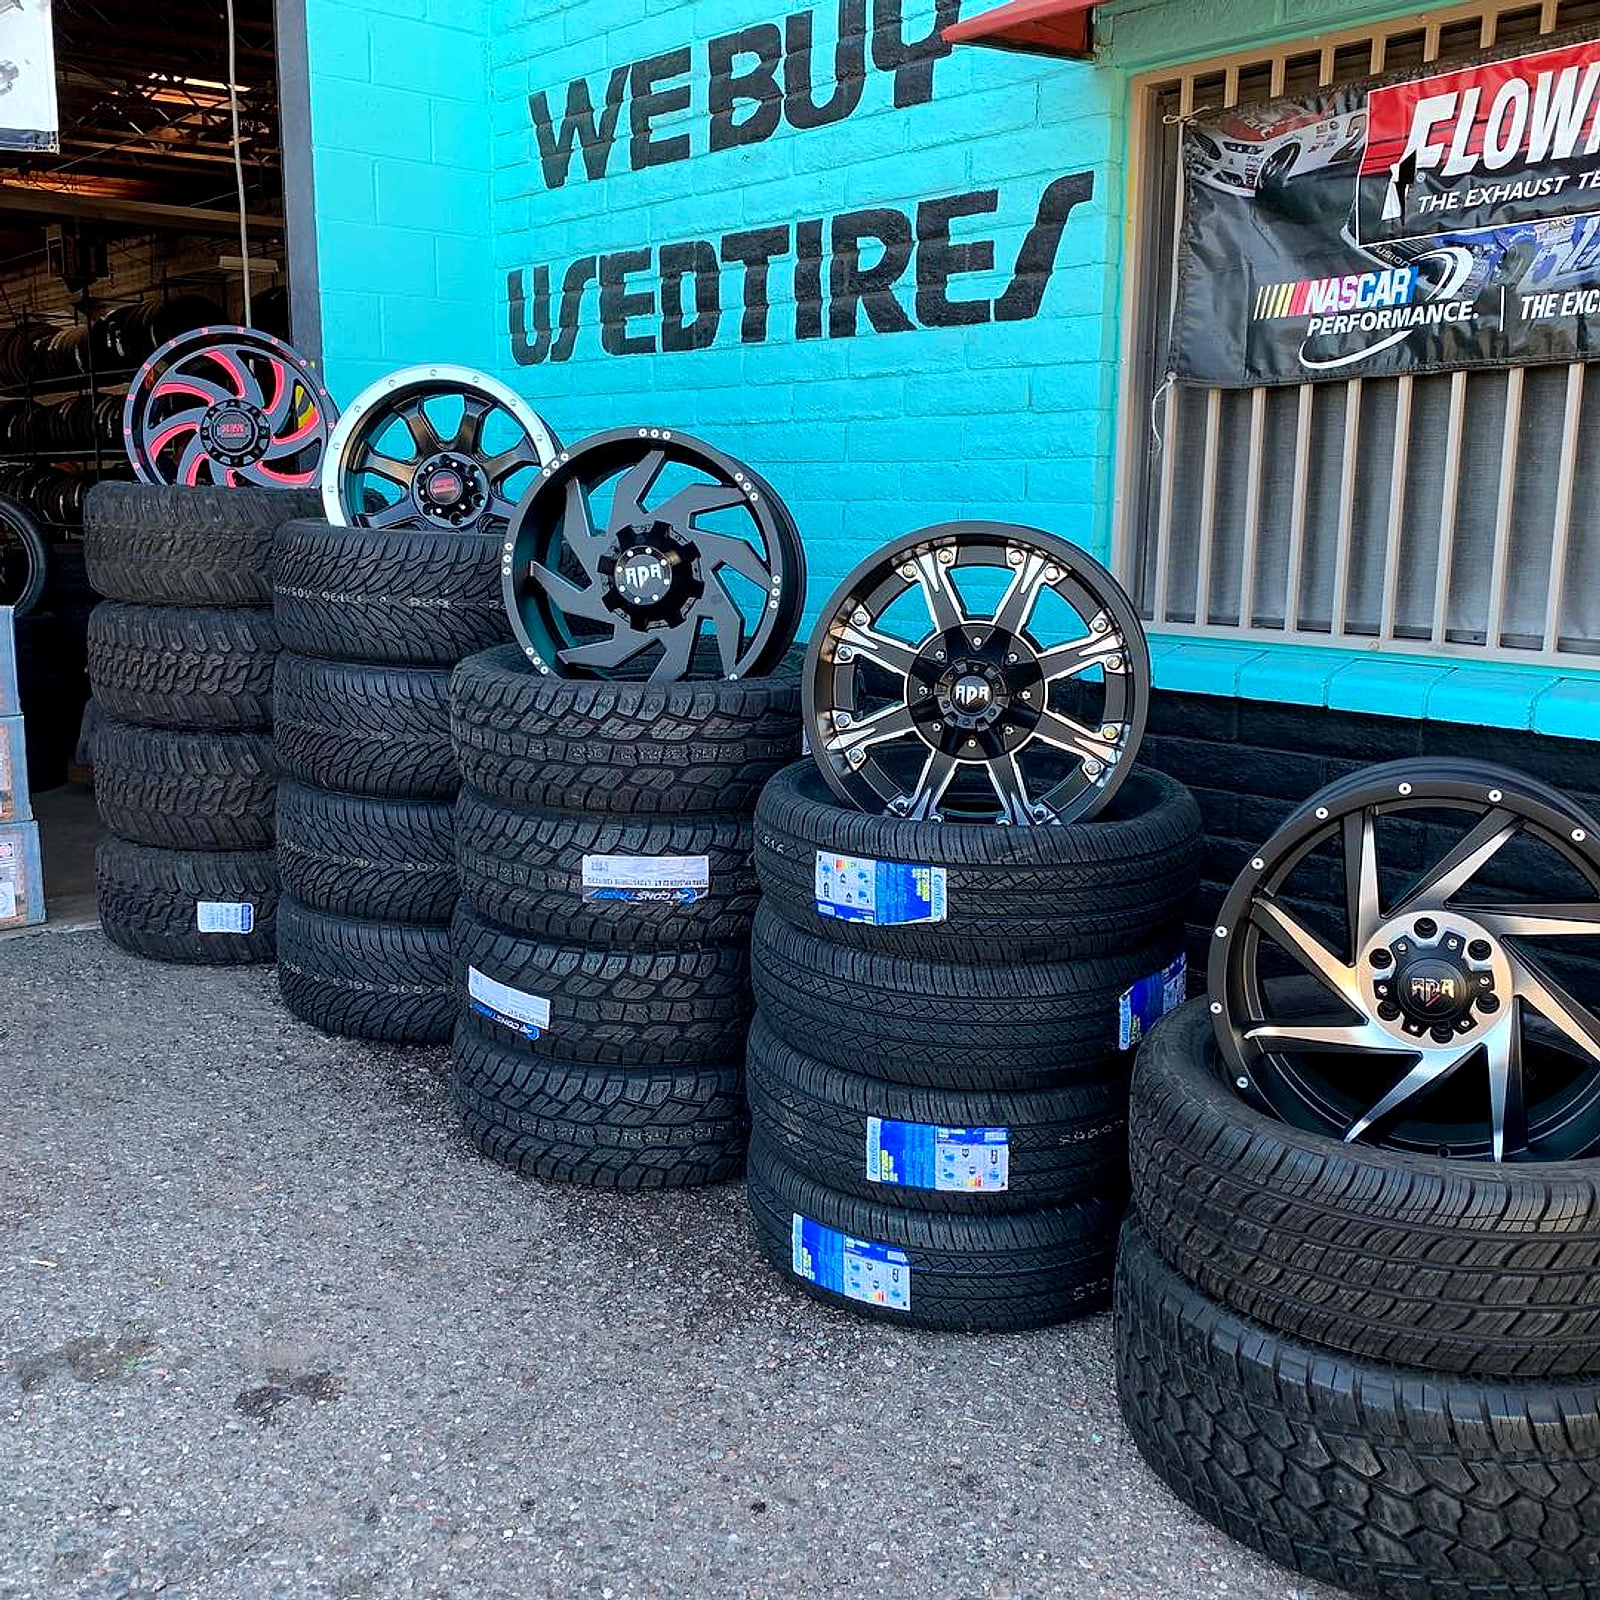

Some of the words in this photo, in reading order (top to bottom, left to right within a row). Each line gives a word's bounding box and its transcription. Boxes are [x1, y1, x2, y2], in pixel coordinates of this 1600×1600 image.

[528, 47, 692, 189] WE
[708, 0, 964, 152] BUY
[1418, 191, 1460, 214] THE
[1463, 175, 1570, 208] EXHAUST
[507, 241, 721, 367] USED
[720, 171, 1095, 344] TIRES
[1303, 266, 1413, 315] NASCAR
[1521, 293, 1560, 320] THE
[1560, 288, 1600, 317] EXC
